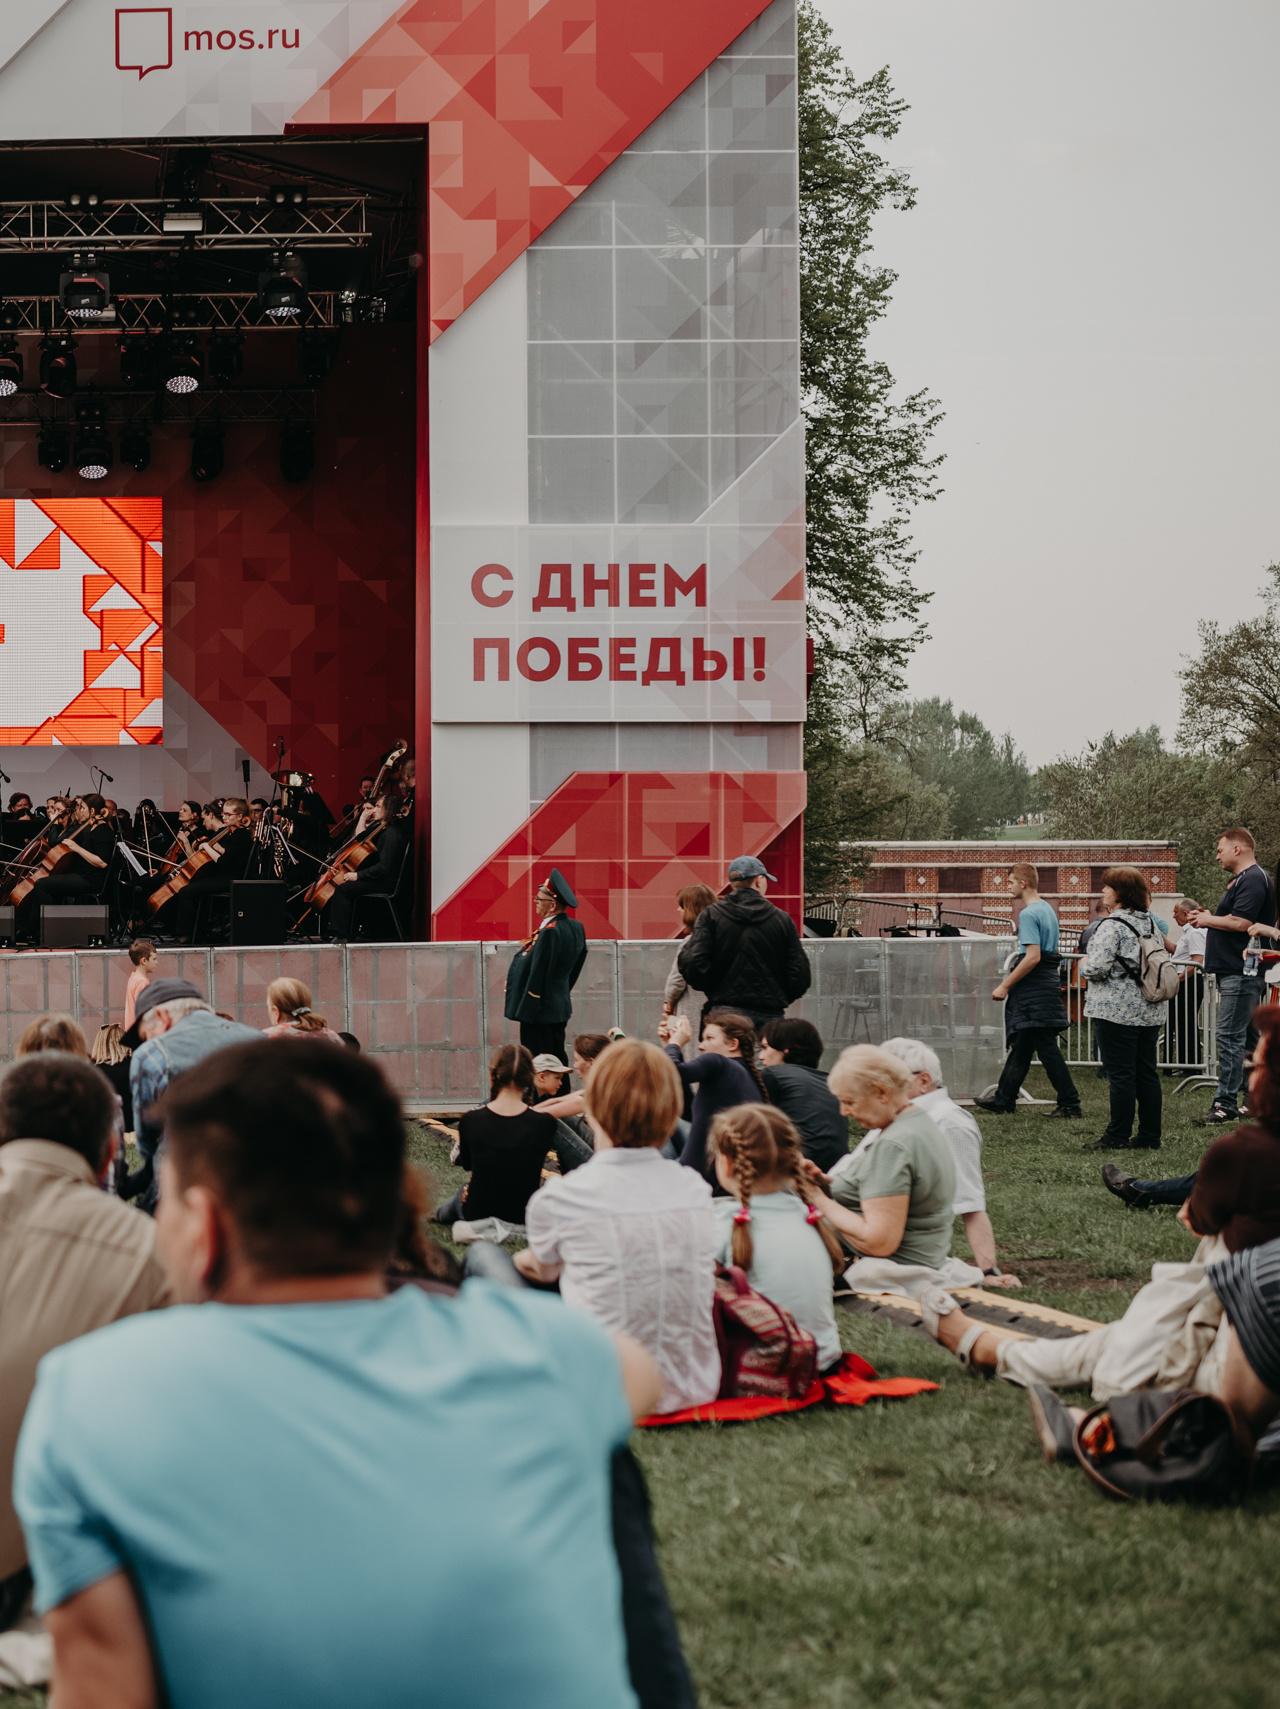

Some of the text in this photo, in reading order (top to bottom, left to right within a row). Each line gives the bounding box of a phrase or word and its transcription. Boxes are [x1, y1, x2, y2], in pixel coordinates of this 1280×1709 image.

[184, 29, 300, 51] mos.ru
[470, 563, 707, 612] С ДНЕМ
[472, 637, 767, 686] ПОБЕДЫ!
